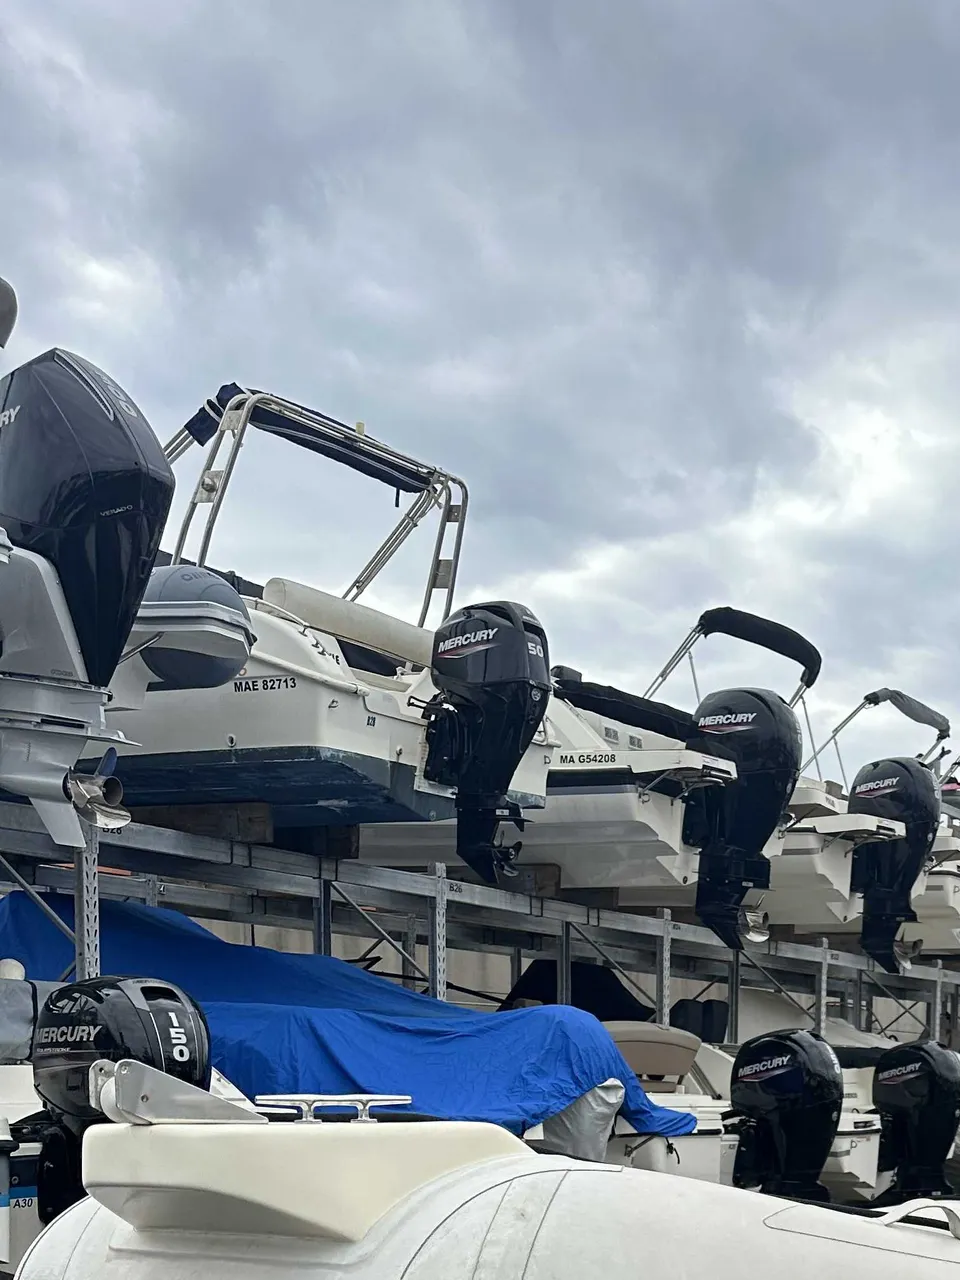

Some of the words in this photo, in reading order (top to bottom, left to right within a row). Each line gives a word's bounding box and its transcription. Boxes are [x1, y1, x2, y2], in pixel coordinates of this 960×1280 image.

[438, 627, 499, 653] MERCURY
[527, 642, 545, 658] 50
[234, 680, 259, 693] MAE
[262, 677, 297, 691] 82713
[698, 713, 757, 727] MERCURY
[559, 754, 576, 764] MA
[578, 754, 617, 764] G54208
[855, 776, 900, 793] MERCURY
[36, 1025, 103, 1043] MERCURY
[168, 1012, 190, 1062] 150
[738, 1054, 791, 1077] MERCURY
[878, 1062, 922, 1080] MERCURY
[13, 1198, 33, 1209] A30
